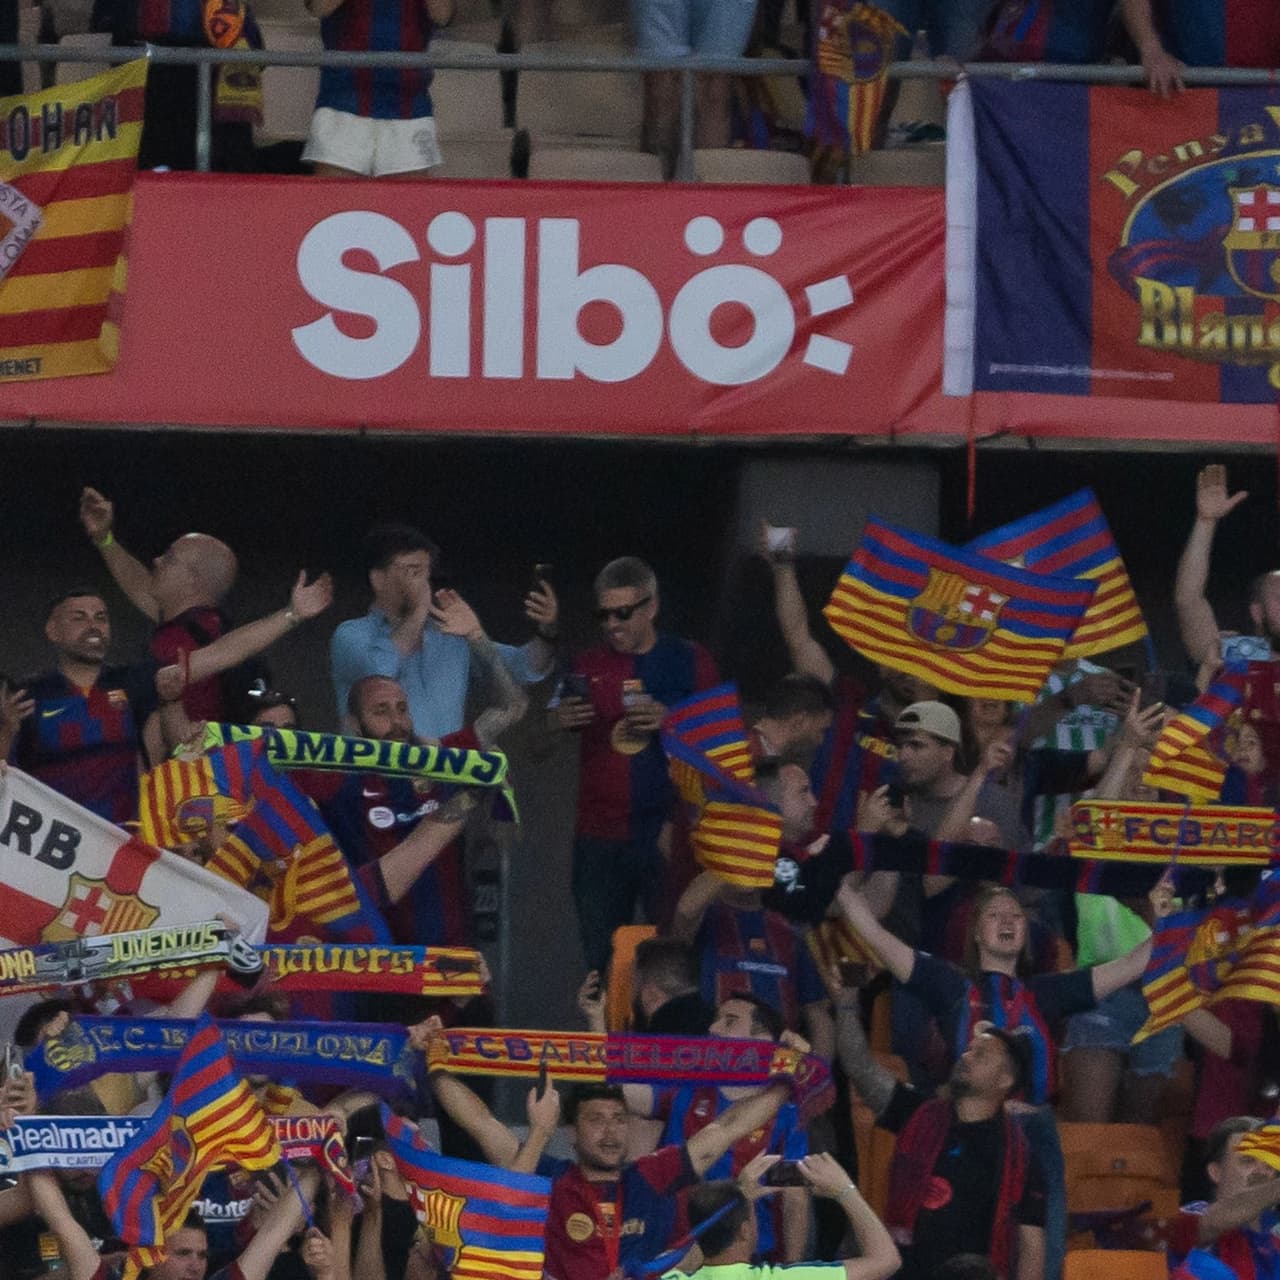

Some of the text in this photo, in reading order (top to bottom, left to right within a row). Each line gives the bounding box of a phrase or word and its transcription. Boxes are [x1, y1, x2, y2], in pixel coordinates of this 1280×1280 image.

[292, 210, 795, 386] Silbö
[106, 923, 220, 966] JUVENTUS
[162, 1025, 393, 1067] BRCELONA
